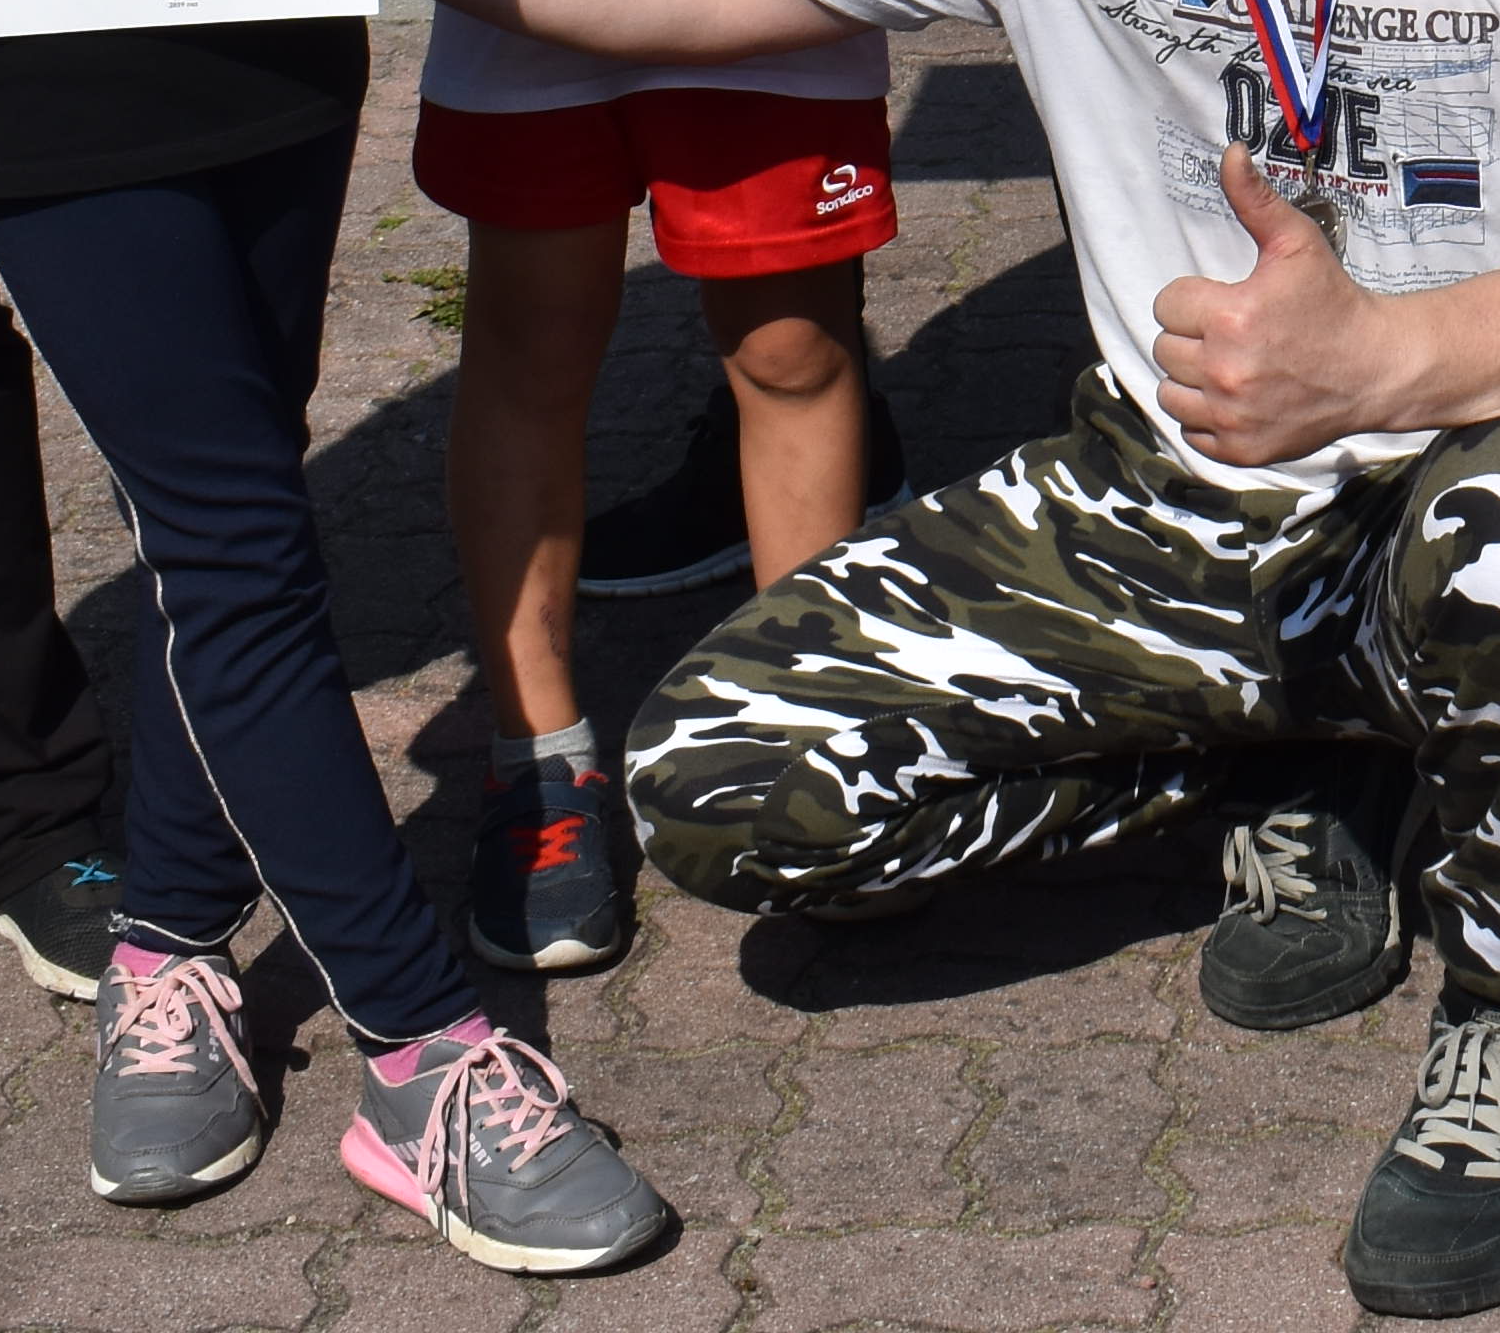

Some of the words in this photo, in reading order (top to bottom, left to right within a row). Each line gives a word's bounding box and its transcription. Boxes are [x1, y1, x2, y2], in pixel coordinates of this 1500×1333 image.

[1425, 8, 1500, 44] CUP
[1099, 0, 1236, 65] Strength
[1366, 73, 1417, 92] sea
[816, 185, 873, 215] Sondico
